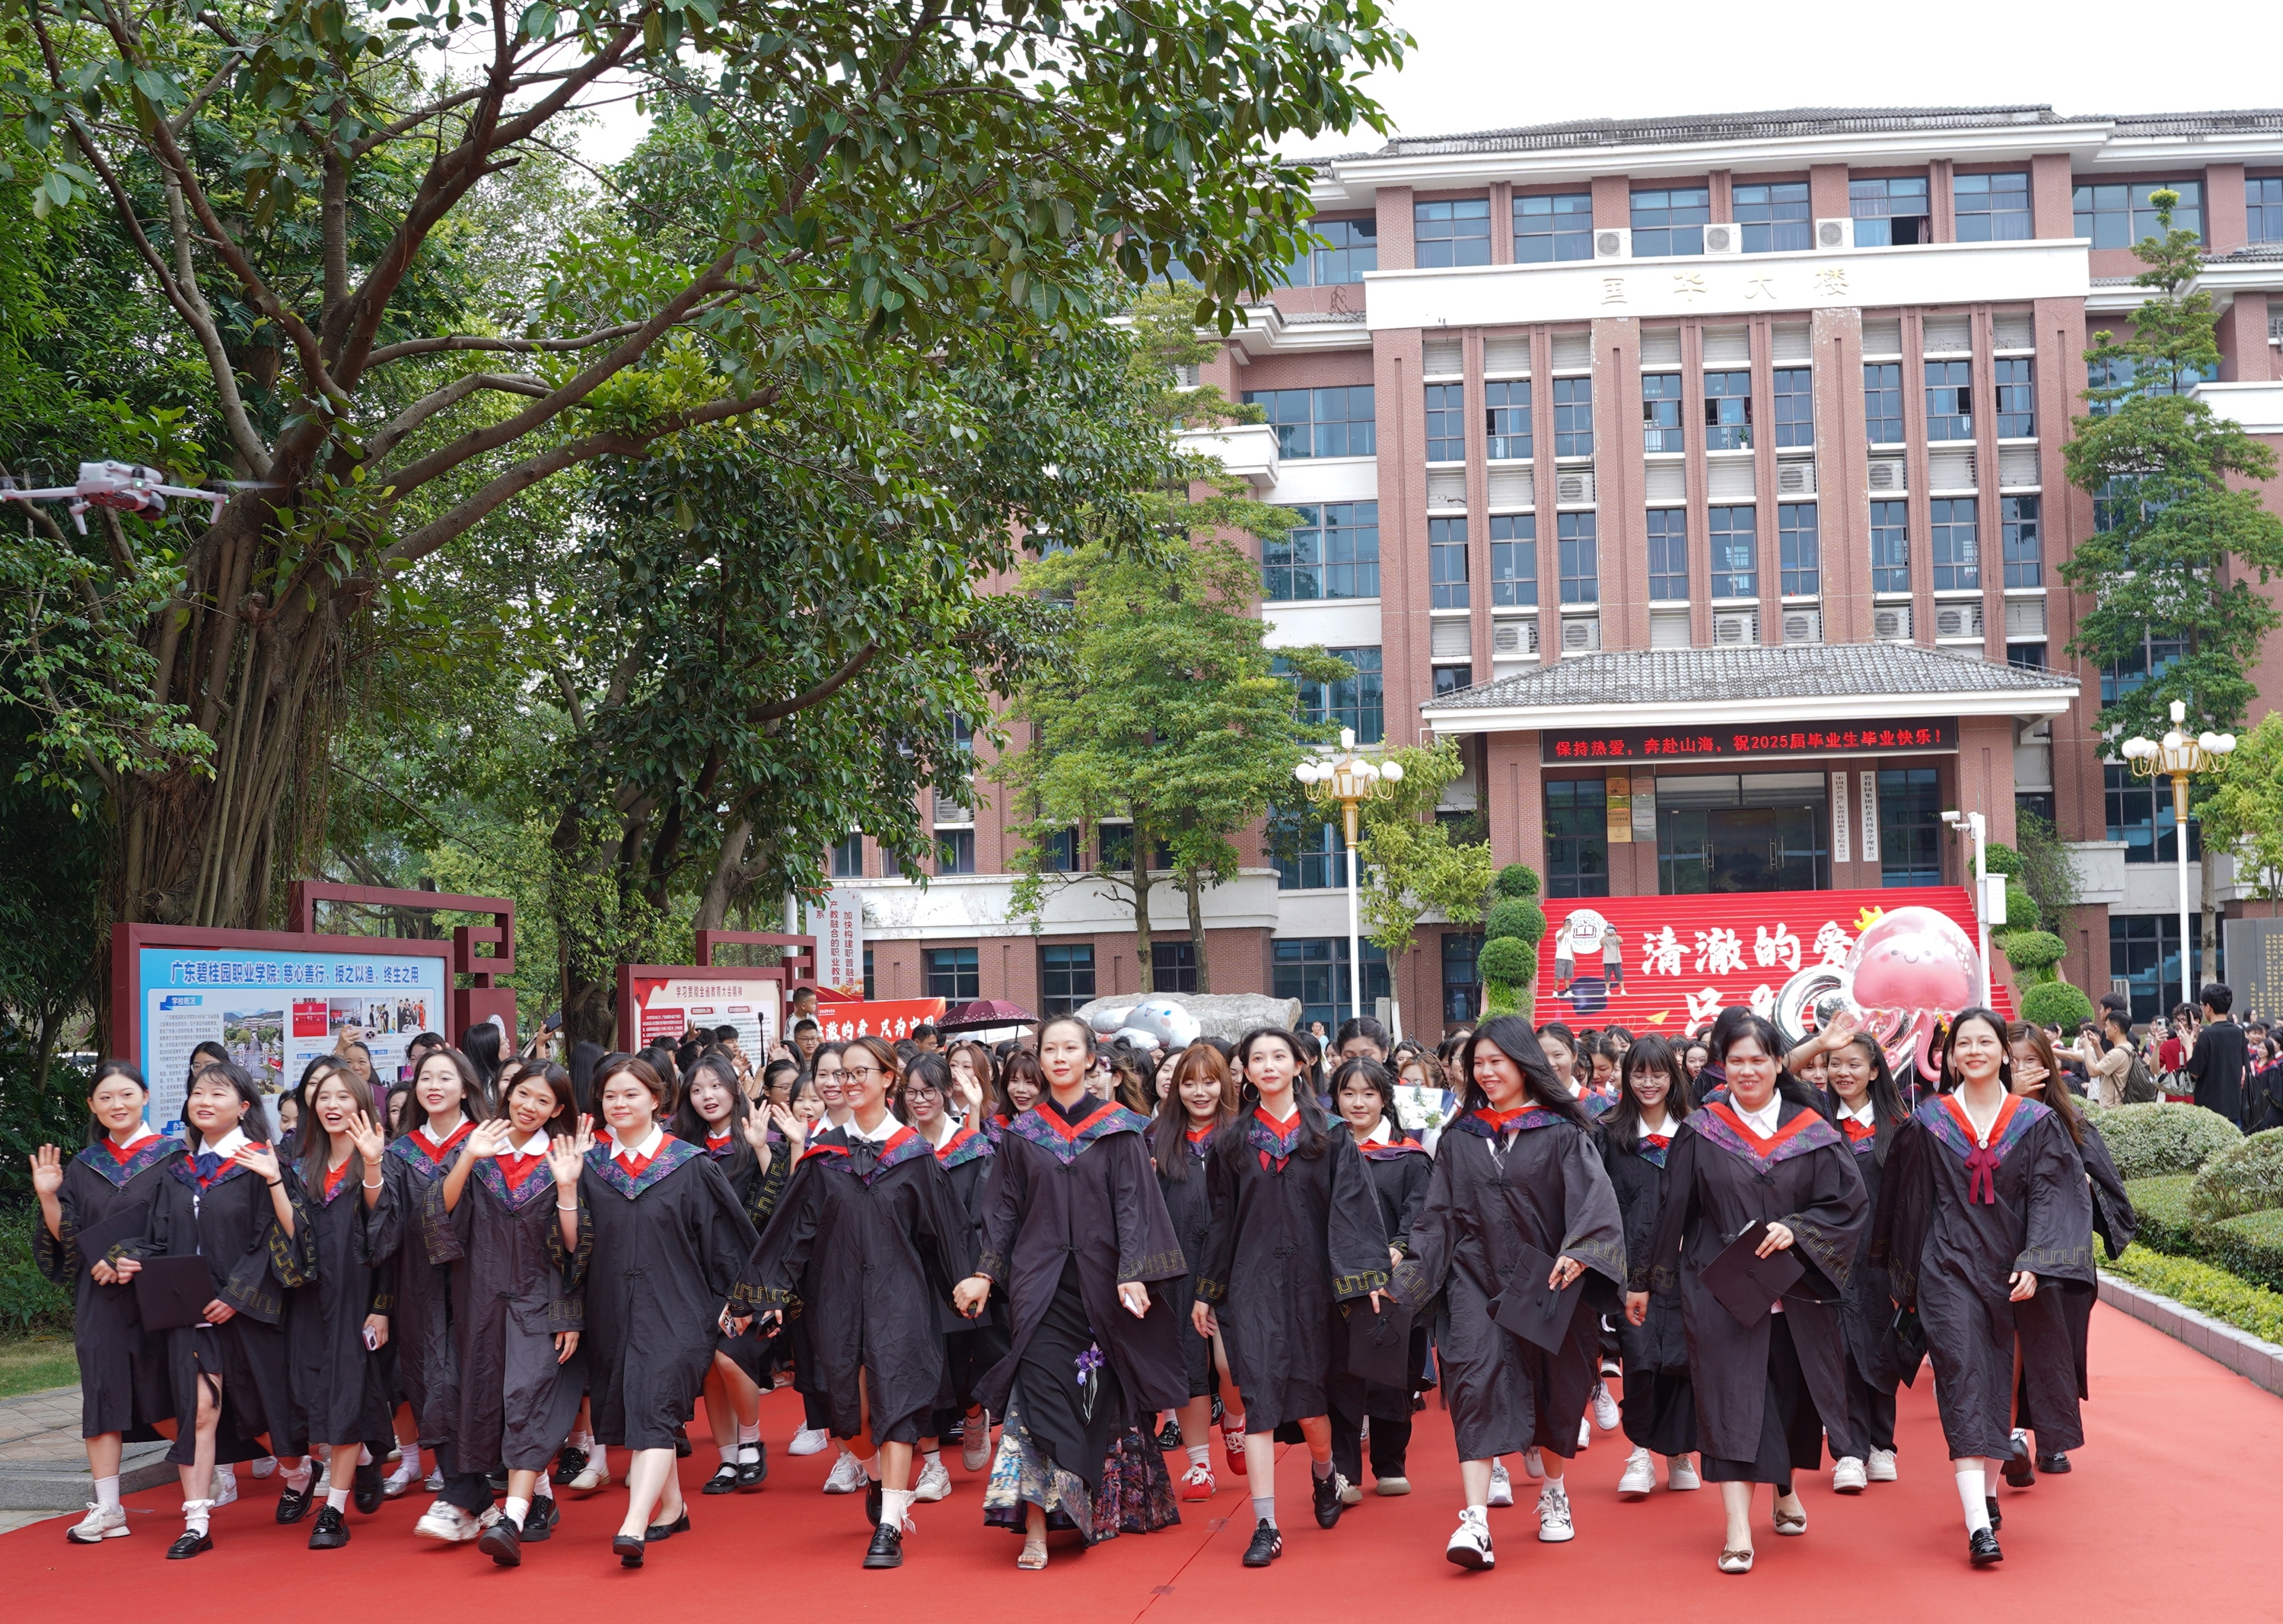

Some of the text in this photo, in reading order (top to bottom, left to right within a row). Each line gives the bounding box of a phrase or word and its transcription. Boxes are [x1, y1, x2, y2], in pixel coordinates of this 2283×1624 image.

[829, 900, 840, 986] 产教融合的职业教育
[843, 910, 855, 986] 加快构建职普融通
[1641, 920, 1855, 977] 清澈的爱
[171, 997, 196, 1005] 学校概况
[676, 985, 743, 998] 学习贯彻全省教育大会精神
